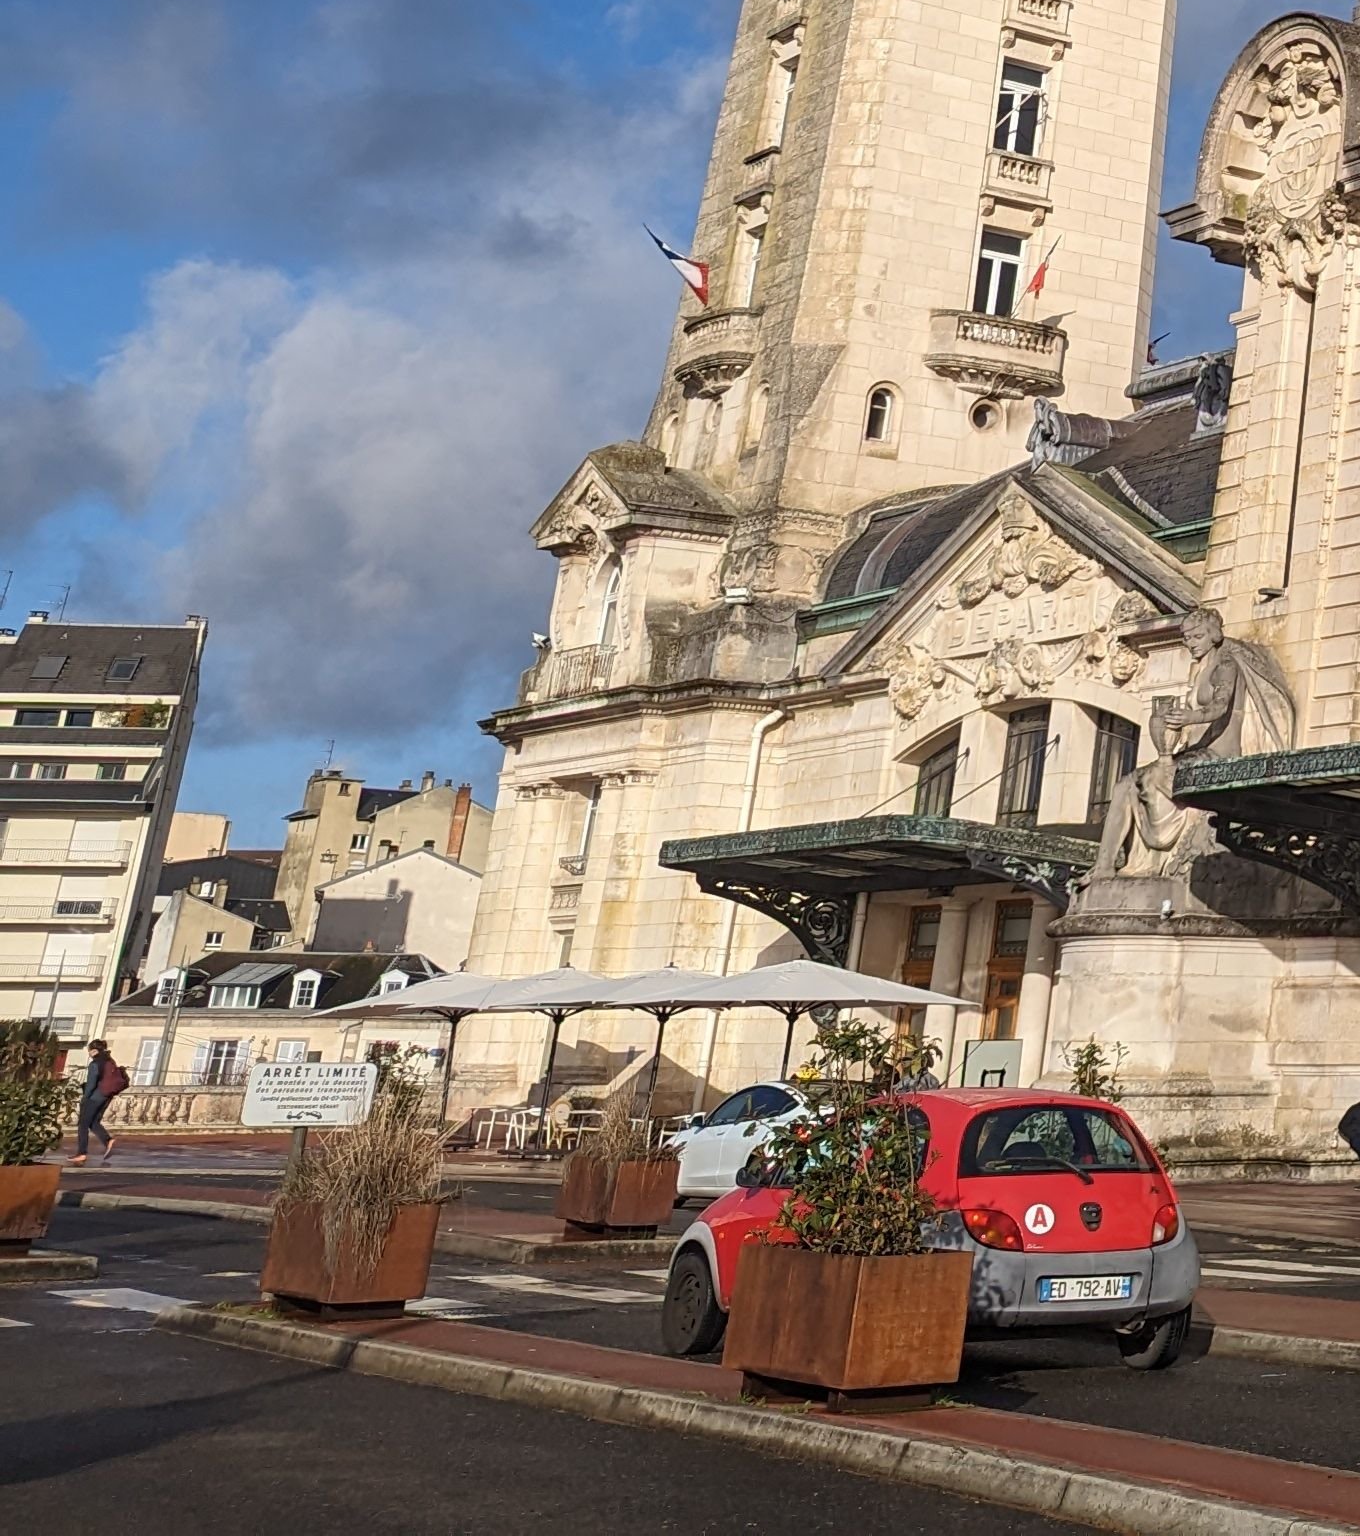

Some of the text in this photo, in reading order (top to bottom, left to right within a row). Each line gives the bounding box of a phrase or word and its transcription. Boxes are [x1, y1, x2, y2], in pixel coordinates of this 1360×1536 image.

[263, 1065, 367, 1078] ARRÊT LIMITÉ
[1032, 1206, 1048, 1228] A
